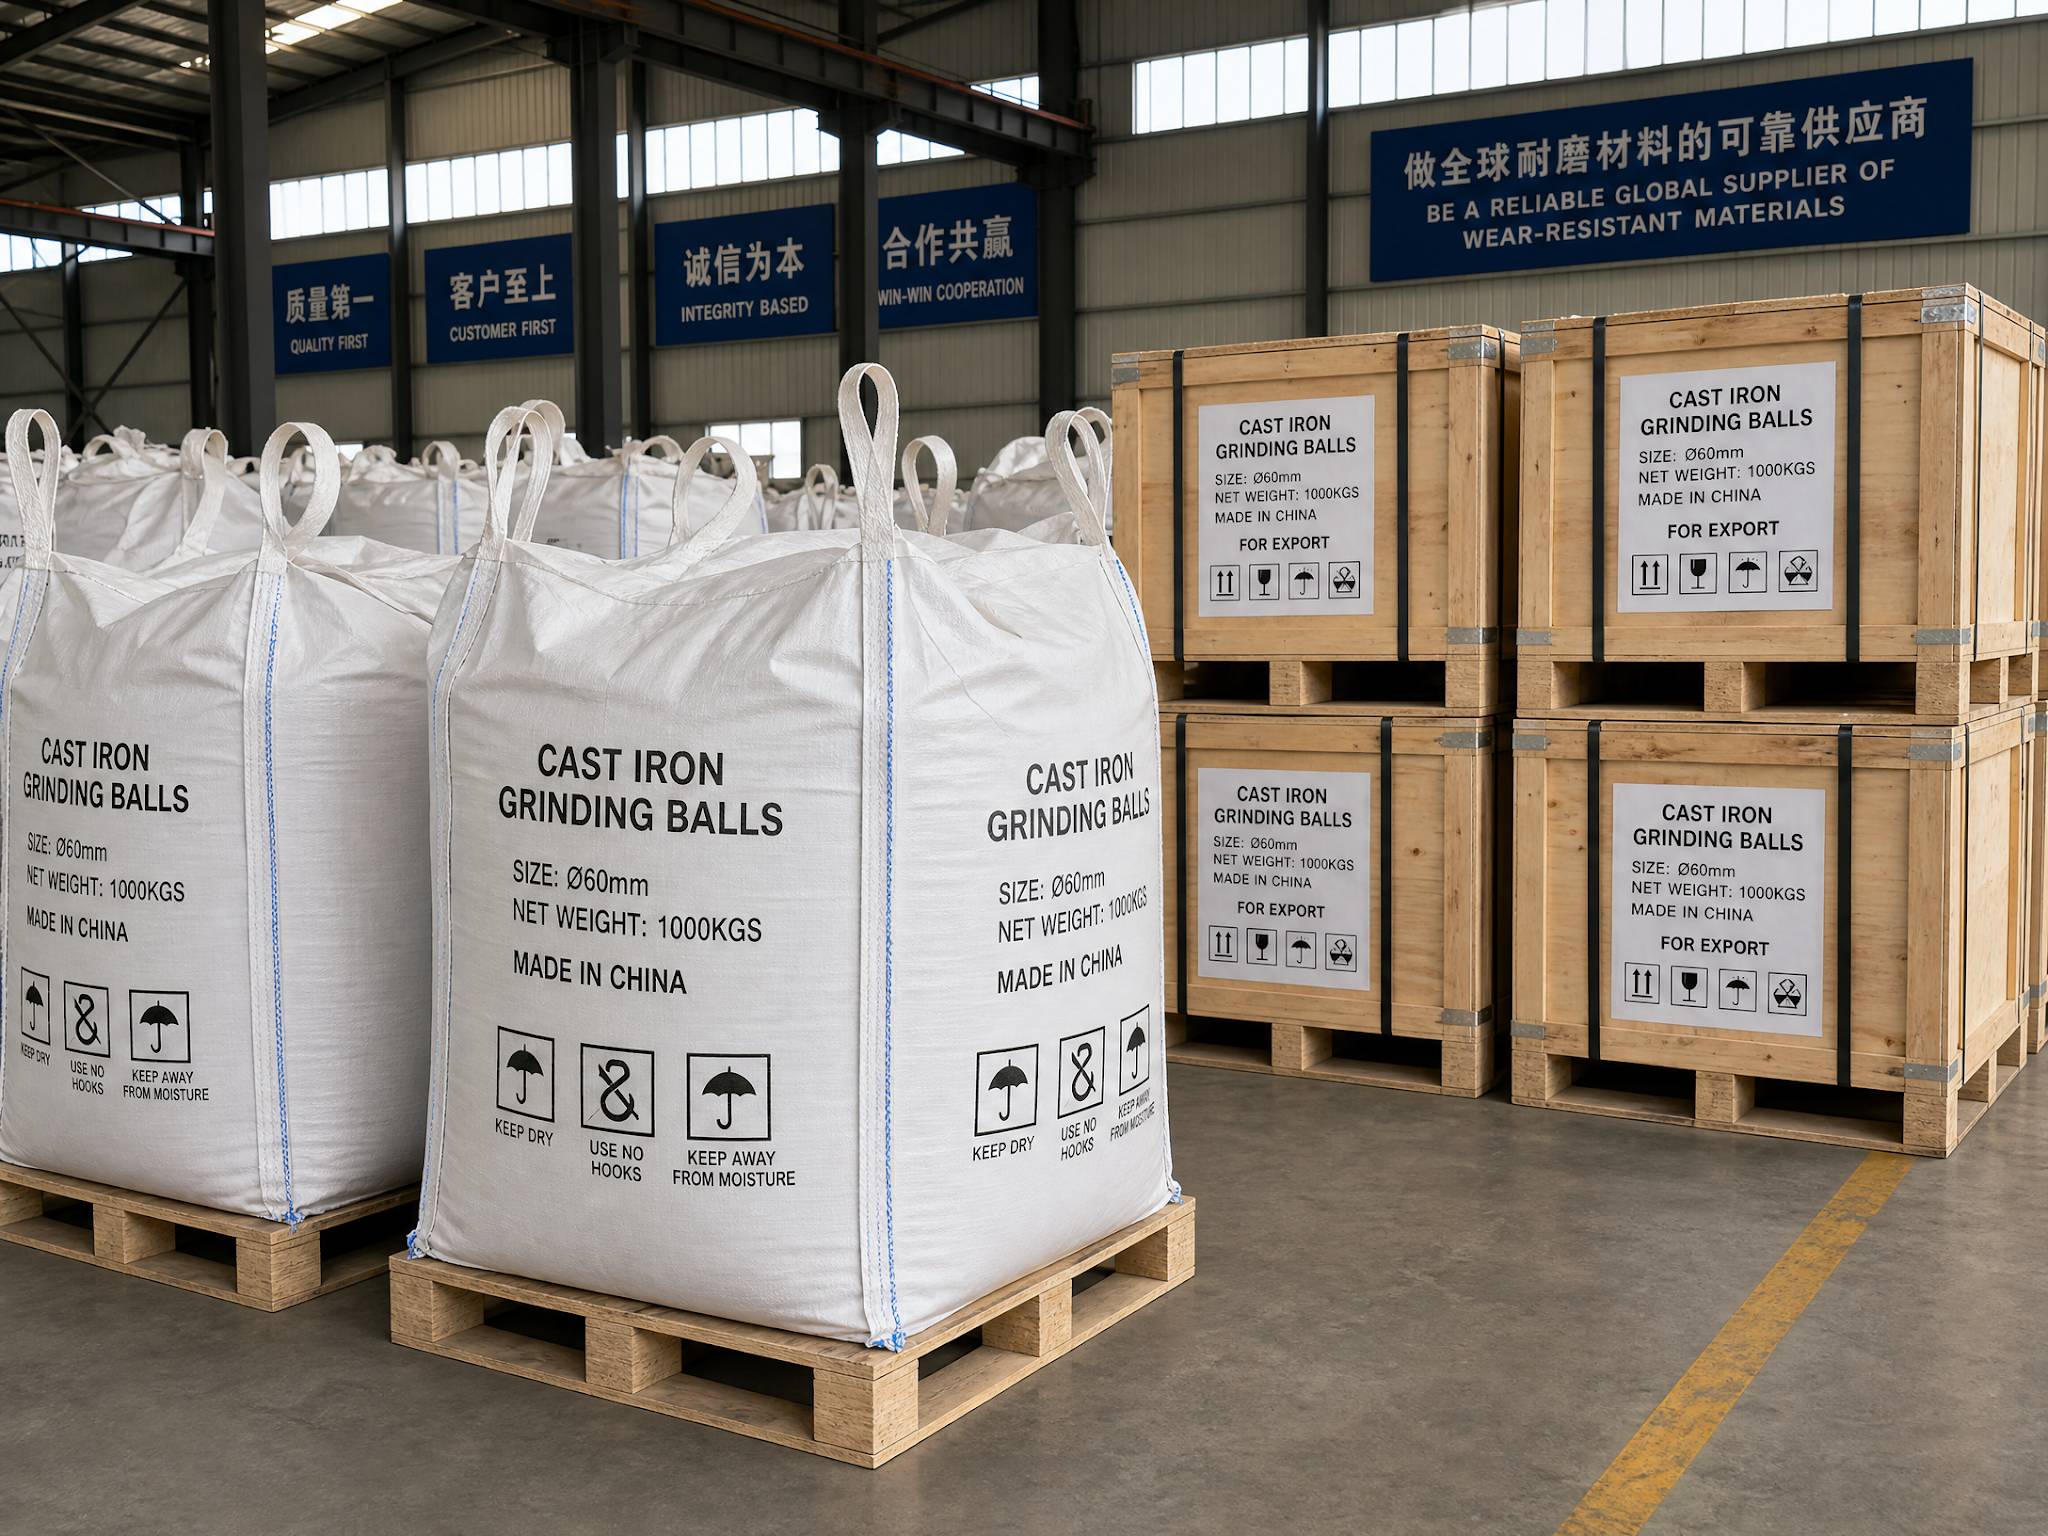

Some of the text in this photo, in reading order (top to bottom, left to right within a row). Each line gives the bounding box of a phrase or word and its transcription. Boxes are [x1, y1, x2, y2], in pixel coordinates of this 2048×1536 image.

[1405, 95, 1928, 191] 做全球耐磨材料的可靠供应商
[1427, 159, 1895, 223] BE A RELIABLE GLOBAL SUPPLIER OF
[1463, 195, 1845, 249] WEAR-RESISTANT MATERIALS
[882, 214, 1013, 270] 合作共赢
[683, 237, 804, 288] 诚信为本
[450, 264, 556, 310] 客户至上
[877, 277, 1024, 306] WIN-WIN COOPERATION
[286, 283, 374, 324] 质量第一
[681, 296, 808, 323] INTEGRITY BASED
[449, 318, 556, 342] CUSTOMER FIRST
[290, 333, 368, 355] QUALITY FIRST
[1669, 384, 1780, 409] CAST IRON
[1239, 415, 1330, 436] CAST IRON
[1641, 408, 1813, 436] GRINDING BALLS
[1216, 436, 1356, 459] GRINDING BALLS
[1639, 447, 1744, 464] SIZE: Ø60mm
[1215, 471, 1301, 486] SIZE: Ø60mm
[1639, 461, 1815, 484] NET WEIGHT: 1000KGS
[1215, 486, 1359, 504] NET WEIGHT: 1000KGS
[1638, 488, 1761, 506] MADE IN CHINA
[1215, 508, 1317, 524] MADE IN CHINA
[1668, 520, 1780, 539] FOR EXPORT
[1240, 536, 1330, 551] FOR EXPORT
[41, 737, 149, 771] CAST IRON
[538, 743, 723, 786] CAST IRON
[1026, 751, 1133, 795] CAST IRON
[23, 771, 189, 813] GRINDING BALLS
[1237, 786, 1327, 804] CAST IRON
[499, 785, 783, 836] GRINDING BALLS
[987, 787, 1150, 842] GRINDING BALLS
[1214, 808, 1352, 828] GRINDING BALLS
[1662, 804, 1772, 824] CAST IRON
[27, 832, 107, 862] SIZE: Ø60mm
[1214, 835, 1297, 851] SIZE: Ø60mm
[1633, 828, 1803, 851] GRINDING BALLS
[1213, 853, 1354, 871] NET WEIGHT: 1000KGS
[1632, 860, 1735, 877] SIZE: Ø60mm
[27, 864, 185, 902] NET WEIGHT: 1000KGS
[513, 859, 648, 896] SIZE: Ø60mm
[999, 871, 1105, 905] SIZE: Ø60mm
[1213, 872, 1312, 889] MADE IN CHINA
[1632, 881, 1805, 901] NET WEIGHT: 1000KGS
[513, 898, 762, 942] NET WEIGHT: 1000KGS
[999, 885, 1147, 943] NET WEIGHT: 1000KGS
[1238, 901, 1325, 918] FOR EXPORT
[1631, 903, 1754, 922] MADE IN CHINA
[27, 905, 128, 942] MADE IN CHINA
[1661, 936, 1770, 956] FOR EXPORT
[514, 949, 687, 994] MADE IN CHINA
[998, 944, 1123, 994] MADE IN CHINA
[36, 1049, 51, 1066] DRY
[70, 1060, 105, 1078] USE NO
[72, 1077, 104, 1095] HOOKS
[132, 1069, 194, 1084] KEEP AWAY
[123, 1085, 209, 1101] FROM MOISTURE
[1118, 1098, 1135, 1119] KEEP
[495, 1118, 554, 1147] KEEP DRY
[1061, 1117, 1097, 1141] USE NO
[1110, 1120, 1130, 1142] FROM
[590, 1139, 644, 1161] USE NO
[688, 1150, 776, 1166] KEEP AWAY
[973, 1135, 1035, 1161] KEEP DRY
[1061, 1136, 1094, 1161] HOOKS
[592, 1160, 642, 1182] HOOKS
[673, 1169, 796, 1187] FROM MOISTURE
